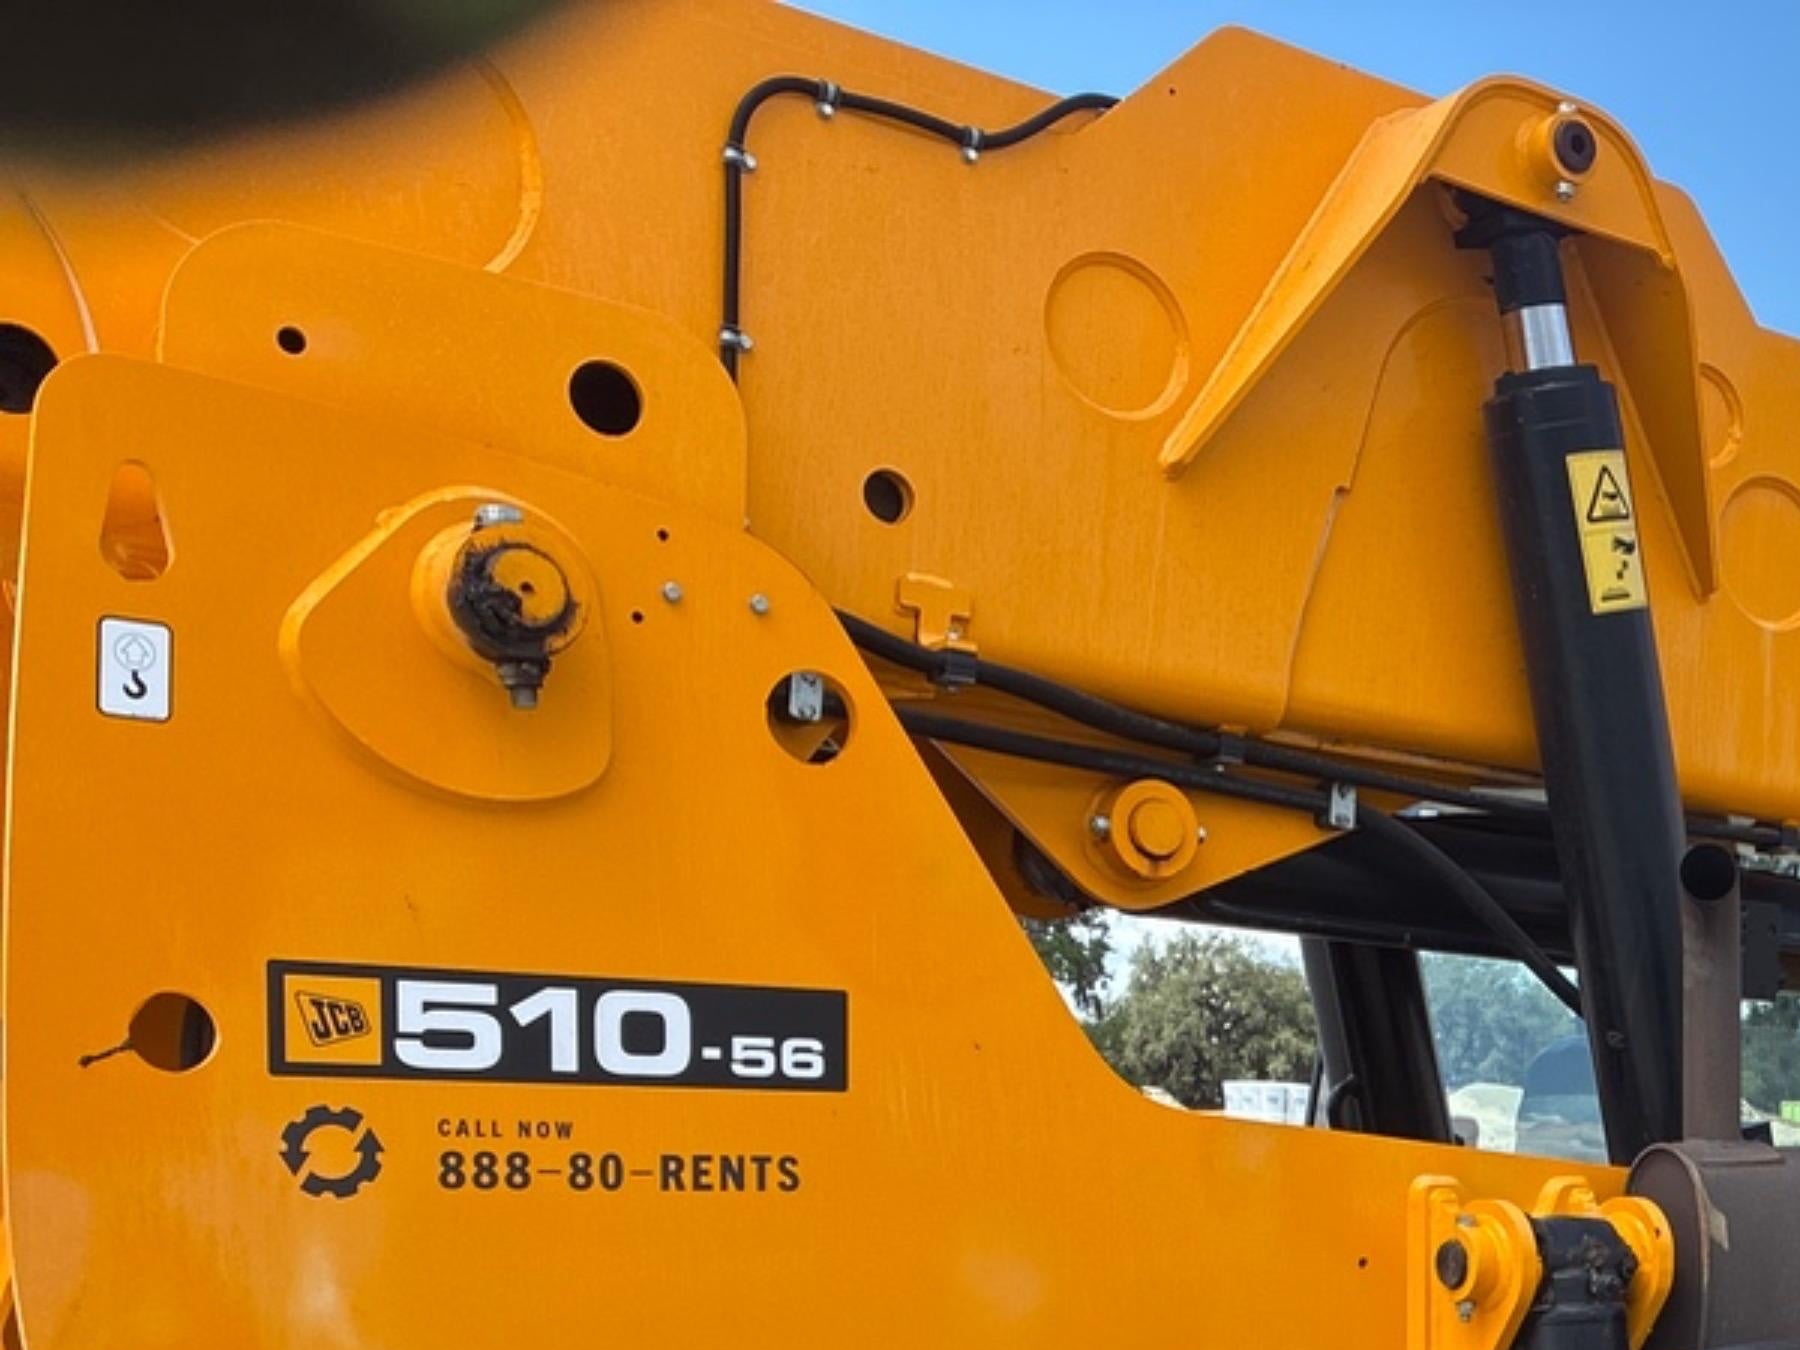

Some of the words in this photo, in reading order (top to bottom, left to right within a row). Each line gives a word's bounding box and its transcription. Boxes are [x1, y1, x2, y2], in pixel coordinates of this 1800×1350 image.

[309, 994, 369, 1041] JCB
[394, 979, 826, 1079] 510-56
[437, 1118, 504, 1138] CALL
[518, 1120, 573, 1139] NOW
[438, 1150, 801, 1192] 888-80-RENTS
